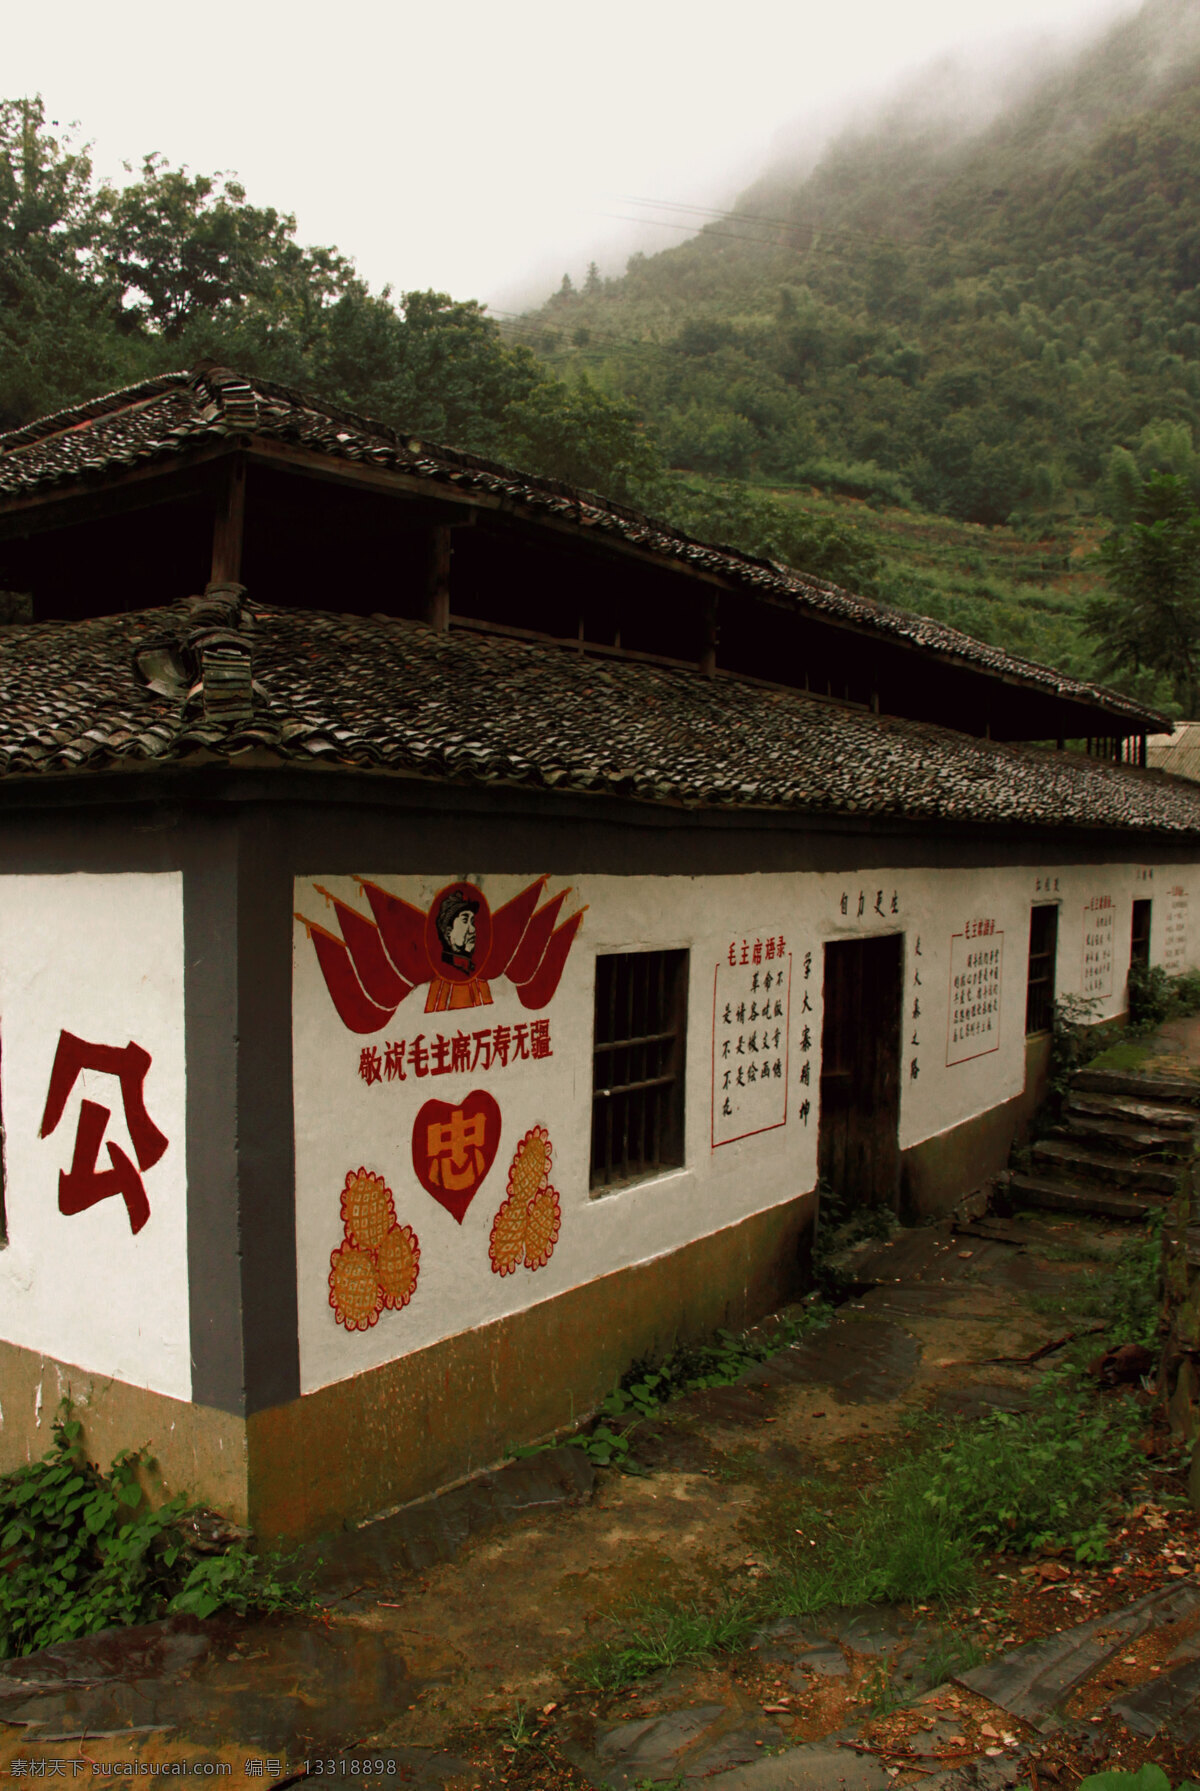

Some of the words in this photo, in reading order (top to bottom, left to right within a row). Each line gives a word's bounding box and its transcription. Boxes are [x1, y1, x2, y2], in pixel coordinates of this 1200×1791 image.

[727, 935, 786, 967] 毛主席语录
[750, 970, 784, 994] 革命不
[722, 998, 783, 1025] 是请客吃饭
[799, 951, 813, 1128] 学大寨精神
[358, 1018, 554, 1086] 敬祝毛主席万寿无疆
[38, 1029, 169, 1236] 公
[426, 1109, 488, 1191] 忠
